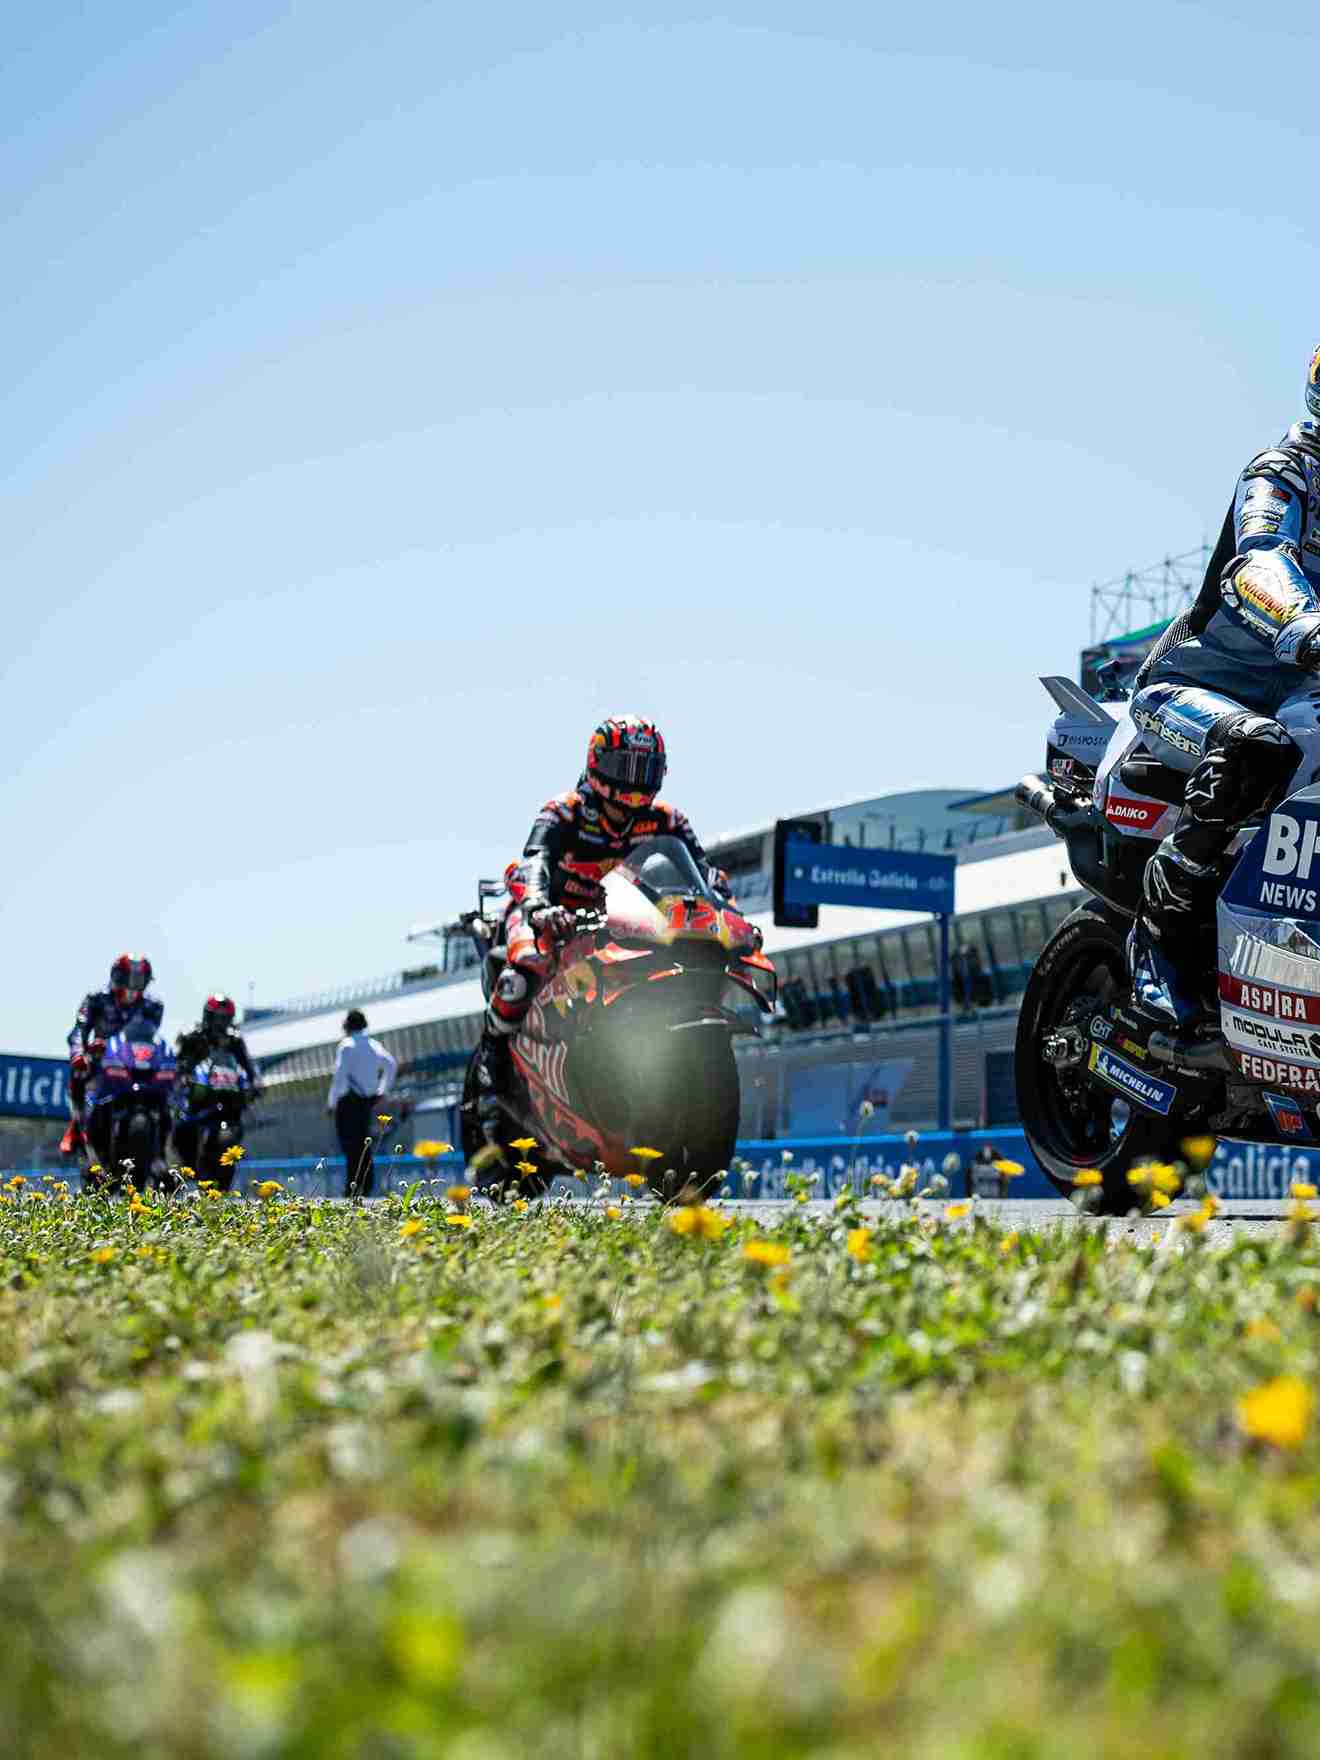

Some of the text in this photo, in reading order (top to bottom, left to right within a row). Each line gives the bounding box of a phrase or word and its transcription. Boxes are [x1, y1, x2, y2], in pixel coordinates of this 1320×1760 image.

[1135, 708, 1201, 756] alpinestars
[1259, 880, 1317, 912] NEWS
[1240, 984, 1307, 1020] ASPIRA
[1232, 1015, 1308, 1050] MODULA
[0, 1066, 64, 1106] lici
[1109, 1065, 1164, 1102] MICHELIN
